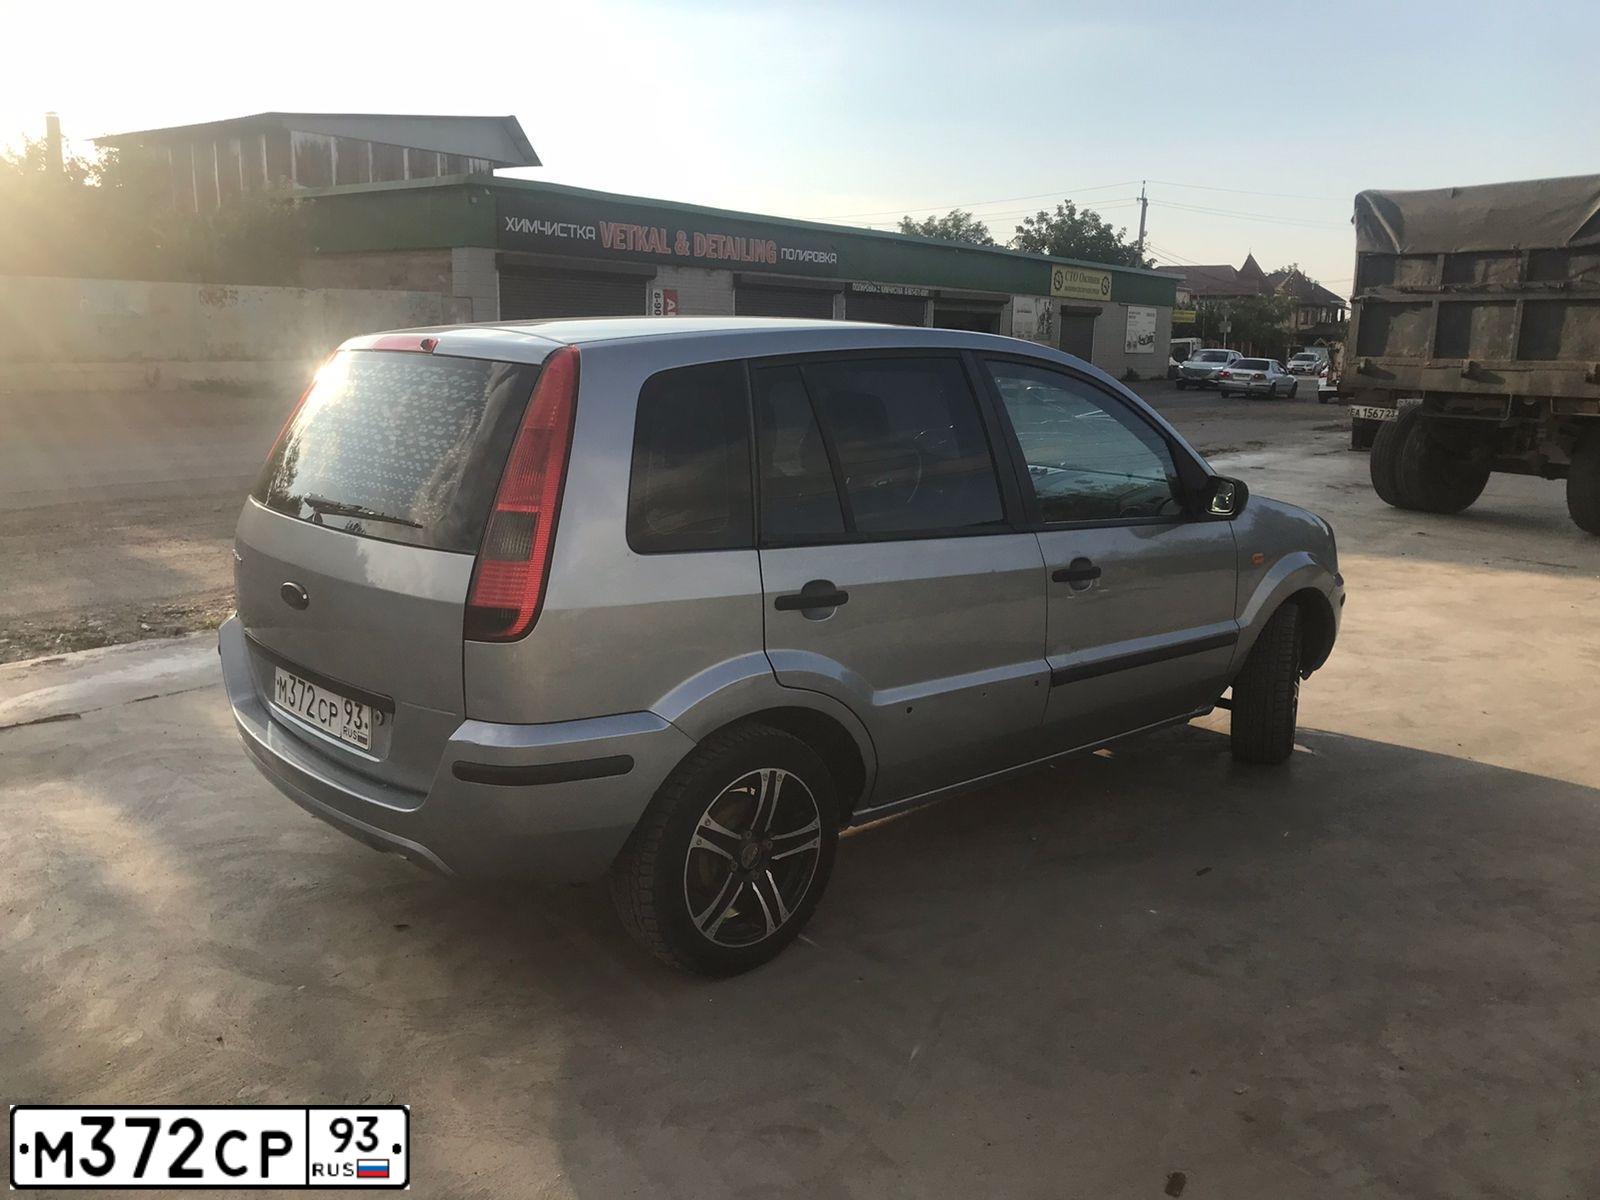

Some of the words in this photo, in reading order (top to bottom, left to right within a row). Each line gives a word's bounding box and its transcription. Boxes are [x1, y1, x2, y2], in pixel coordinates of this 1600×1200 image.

[505, 216, 596, 240] ХИМЧИСТКА
[600, 220, 671, 255] VETKAL
[675, 230, 690, 256] &
[693, 231, 778, 264] DETAILING
[781, 247, 838, 265] ПОЛИРОВКА
[1363, 408, 1385, 419] 1567
[279, 674, 338, 727] М372СР
[344, 700, 363, 730] 93
[343, 726, 358, 741] RUS
